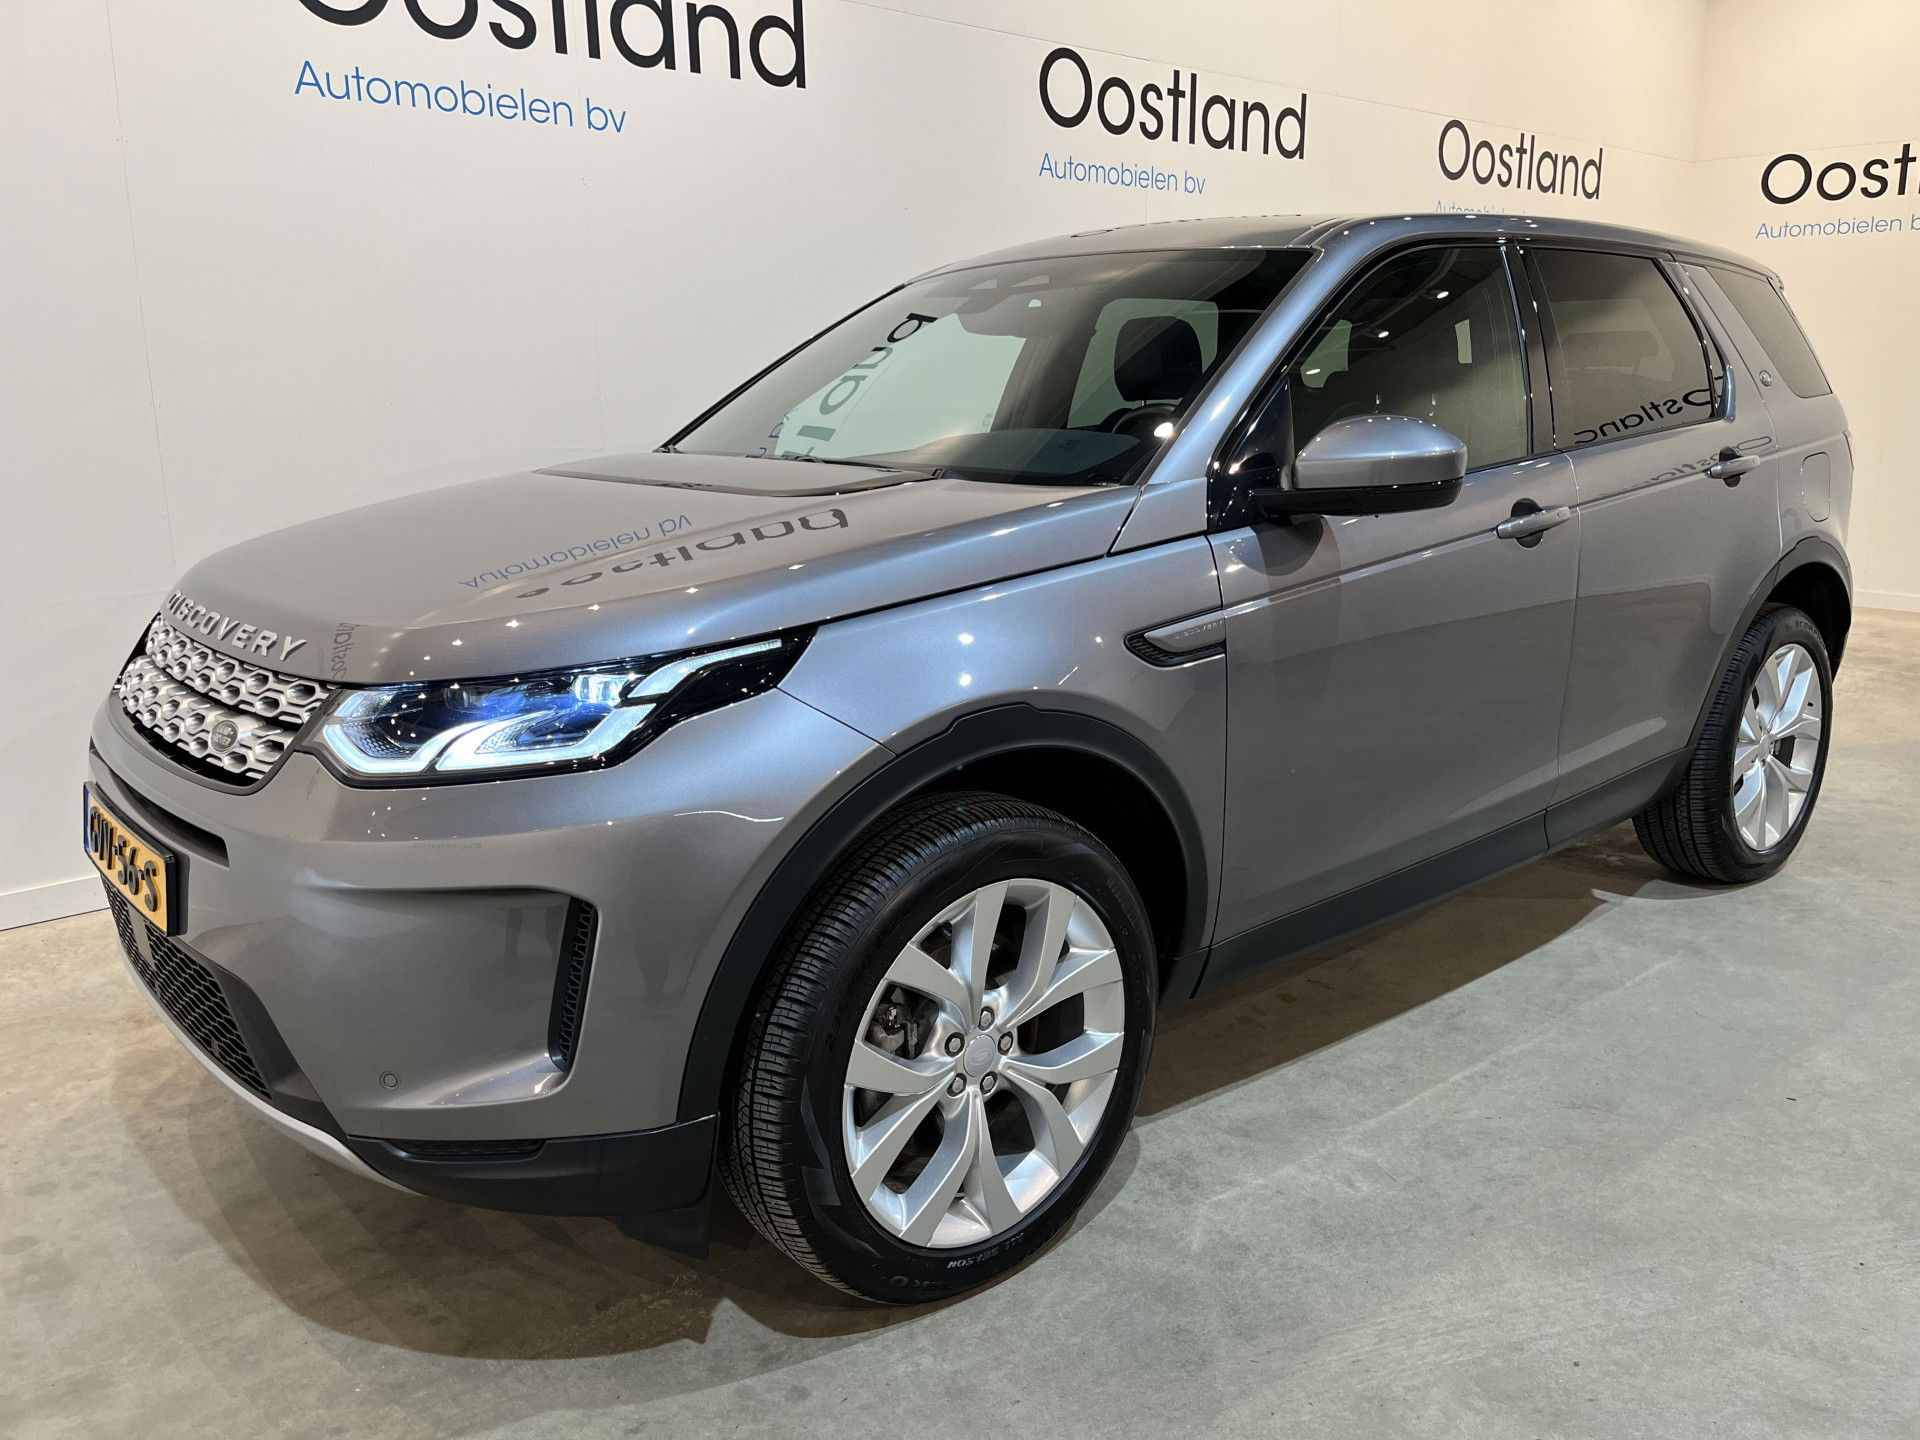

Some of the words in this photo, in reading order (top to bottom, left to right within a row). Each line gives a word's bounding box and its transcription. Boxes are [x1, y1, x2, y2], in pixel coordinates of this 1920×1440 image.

[294, 60, 575, 128] Automobielen
[585, 97, 627, 134] bv
[1039, 47, 1307, 160] Oostland
[1039, 152, 1179, 192] Automobielen
[1184, 170, 1206, 194] bv
[1438, 119, 1603, 200] Oostland
[1761, 143, 1920, 204] Oost
[1755, 216, 1902, 239] Automobielen
[168, 588, 308, 662] DISCOVERY
